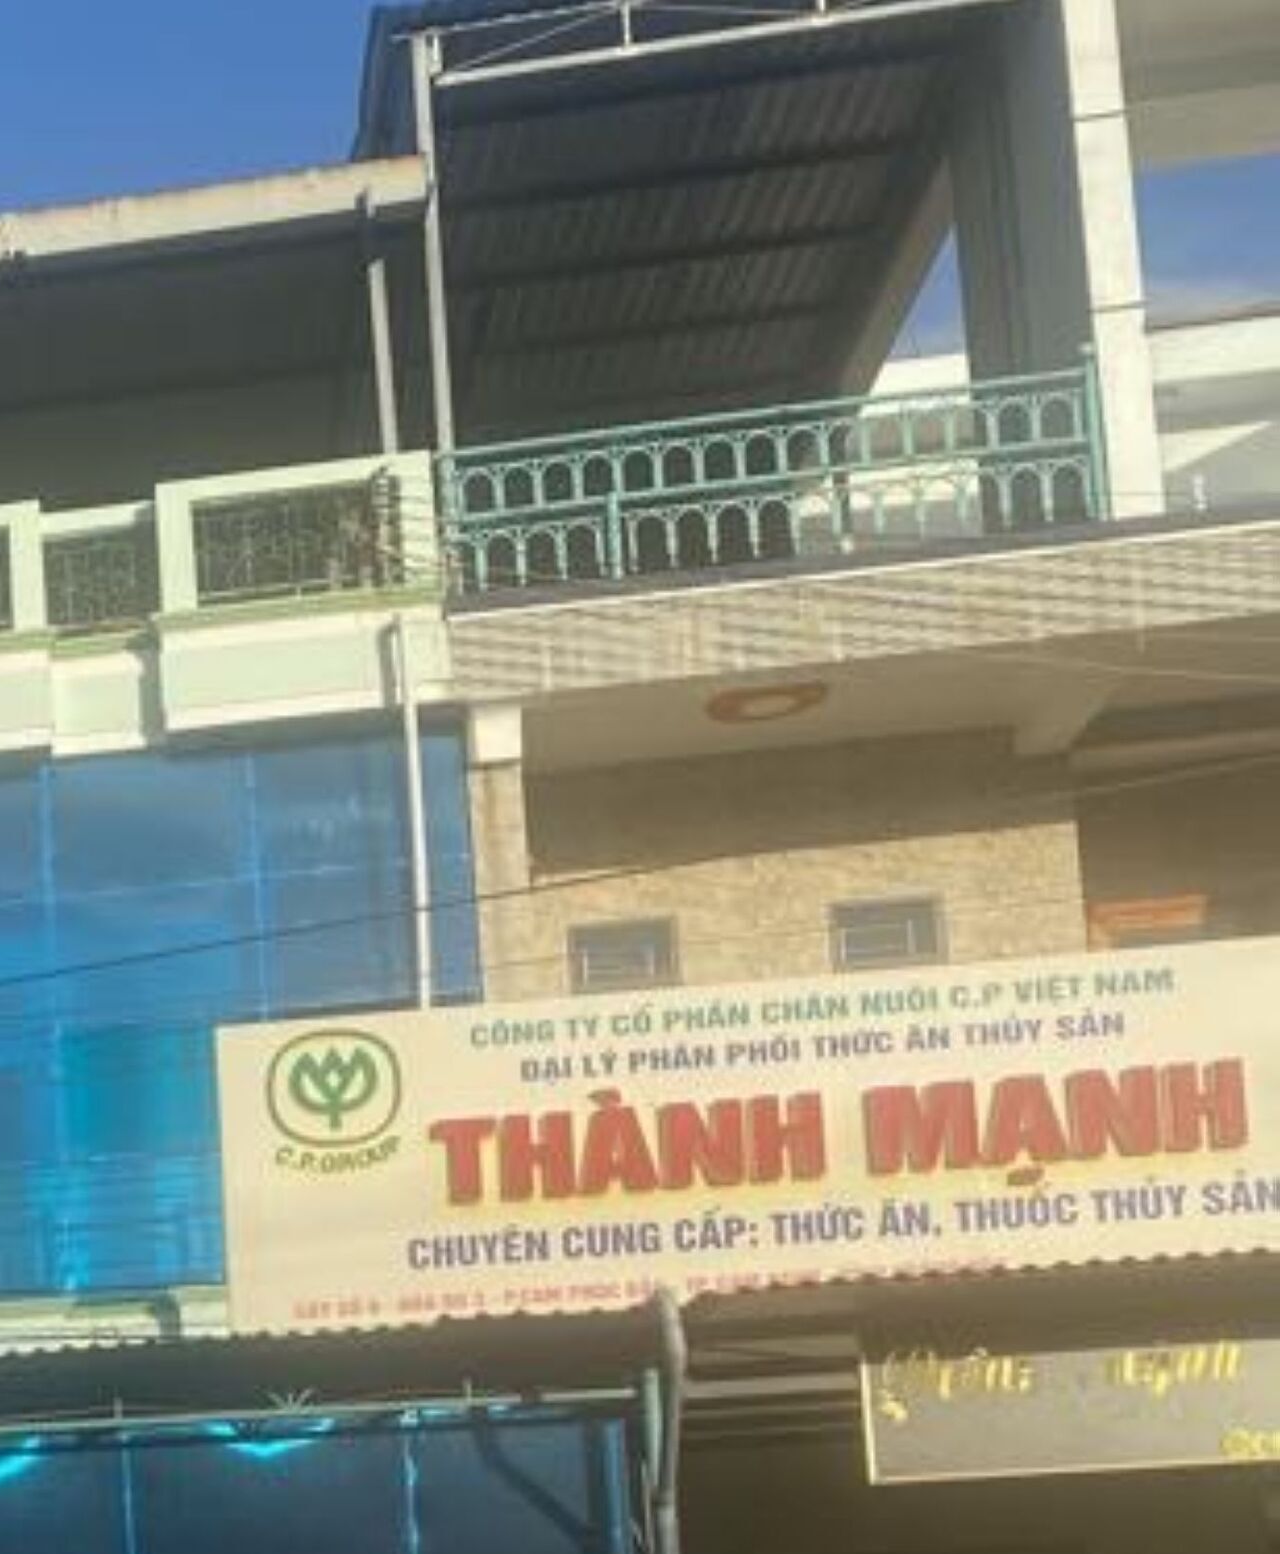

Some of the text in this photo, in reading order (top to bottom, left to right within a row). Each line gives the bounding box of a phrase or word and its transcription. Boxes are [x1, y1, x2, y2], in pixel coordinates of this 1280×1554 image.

[471, 1018, 554, 1047] CÔNG
[564, 1017, 598, 1041] TY
[1094, 967, 1175, 996] NAM
[429, 1057, 1249, 1206] THÀNH MẠNH
[407, 1225, 550, 1270] CHUYÊN
[561, 1221, 662, 1259] CUNG
[673, 1205, 759, 1250] CẤP:
[769, 1202, 863, 1245] THỨC
[954, 1183, 1079, 1233] THUỐC
[1090, 1176, 1187, 1222] THỦY
[1202, 1169, 1280, 1215] SẢN
